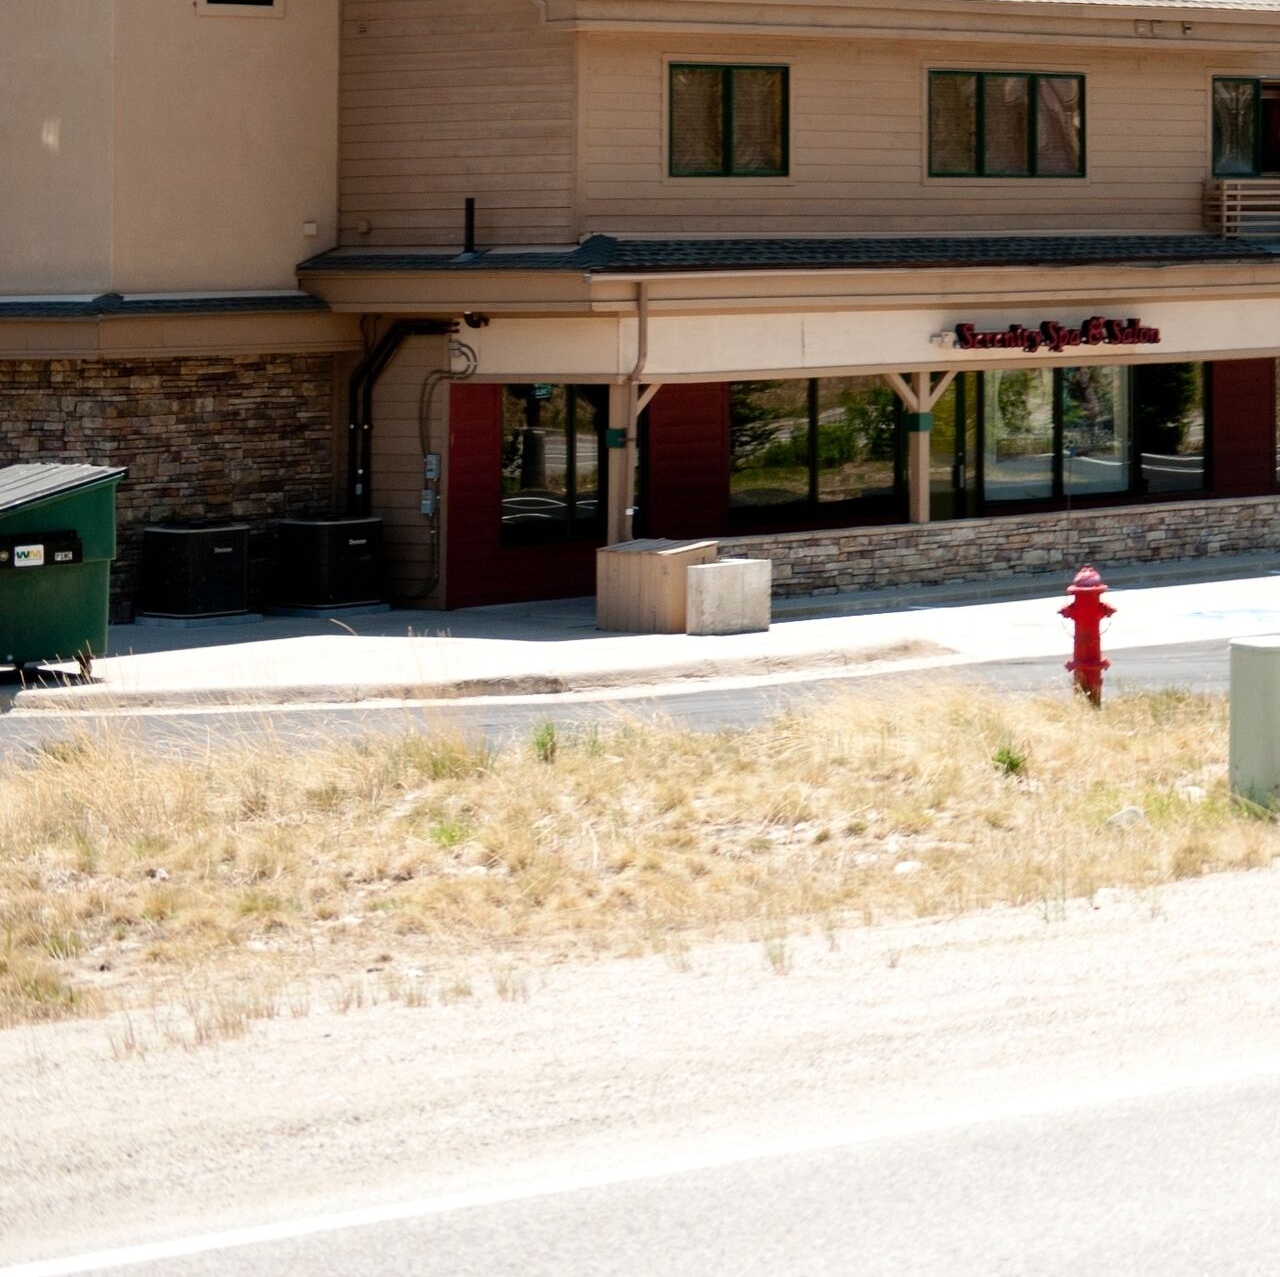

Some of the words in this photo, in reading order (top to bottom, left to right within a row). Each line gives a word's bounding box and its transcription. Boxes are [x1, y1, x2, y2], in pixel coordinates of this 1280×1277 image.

[956, 323, 1041, 352] Serenity
[1041, 320, 1081, 352] Spa
[1083, 317, 1105, 344] &
[1107, 318, 1160, 344] Salon
